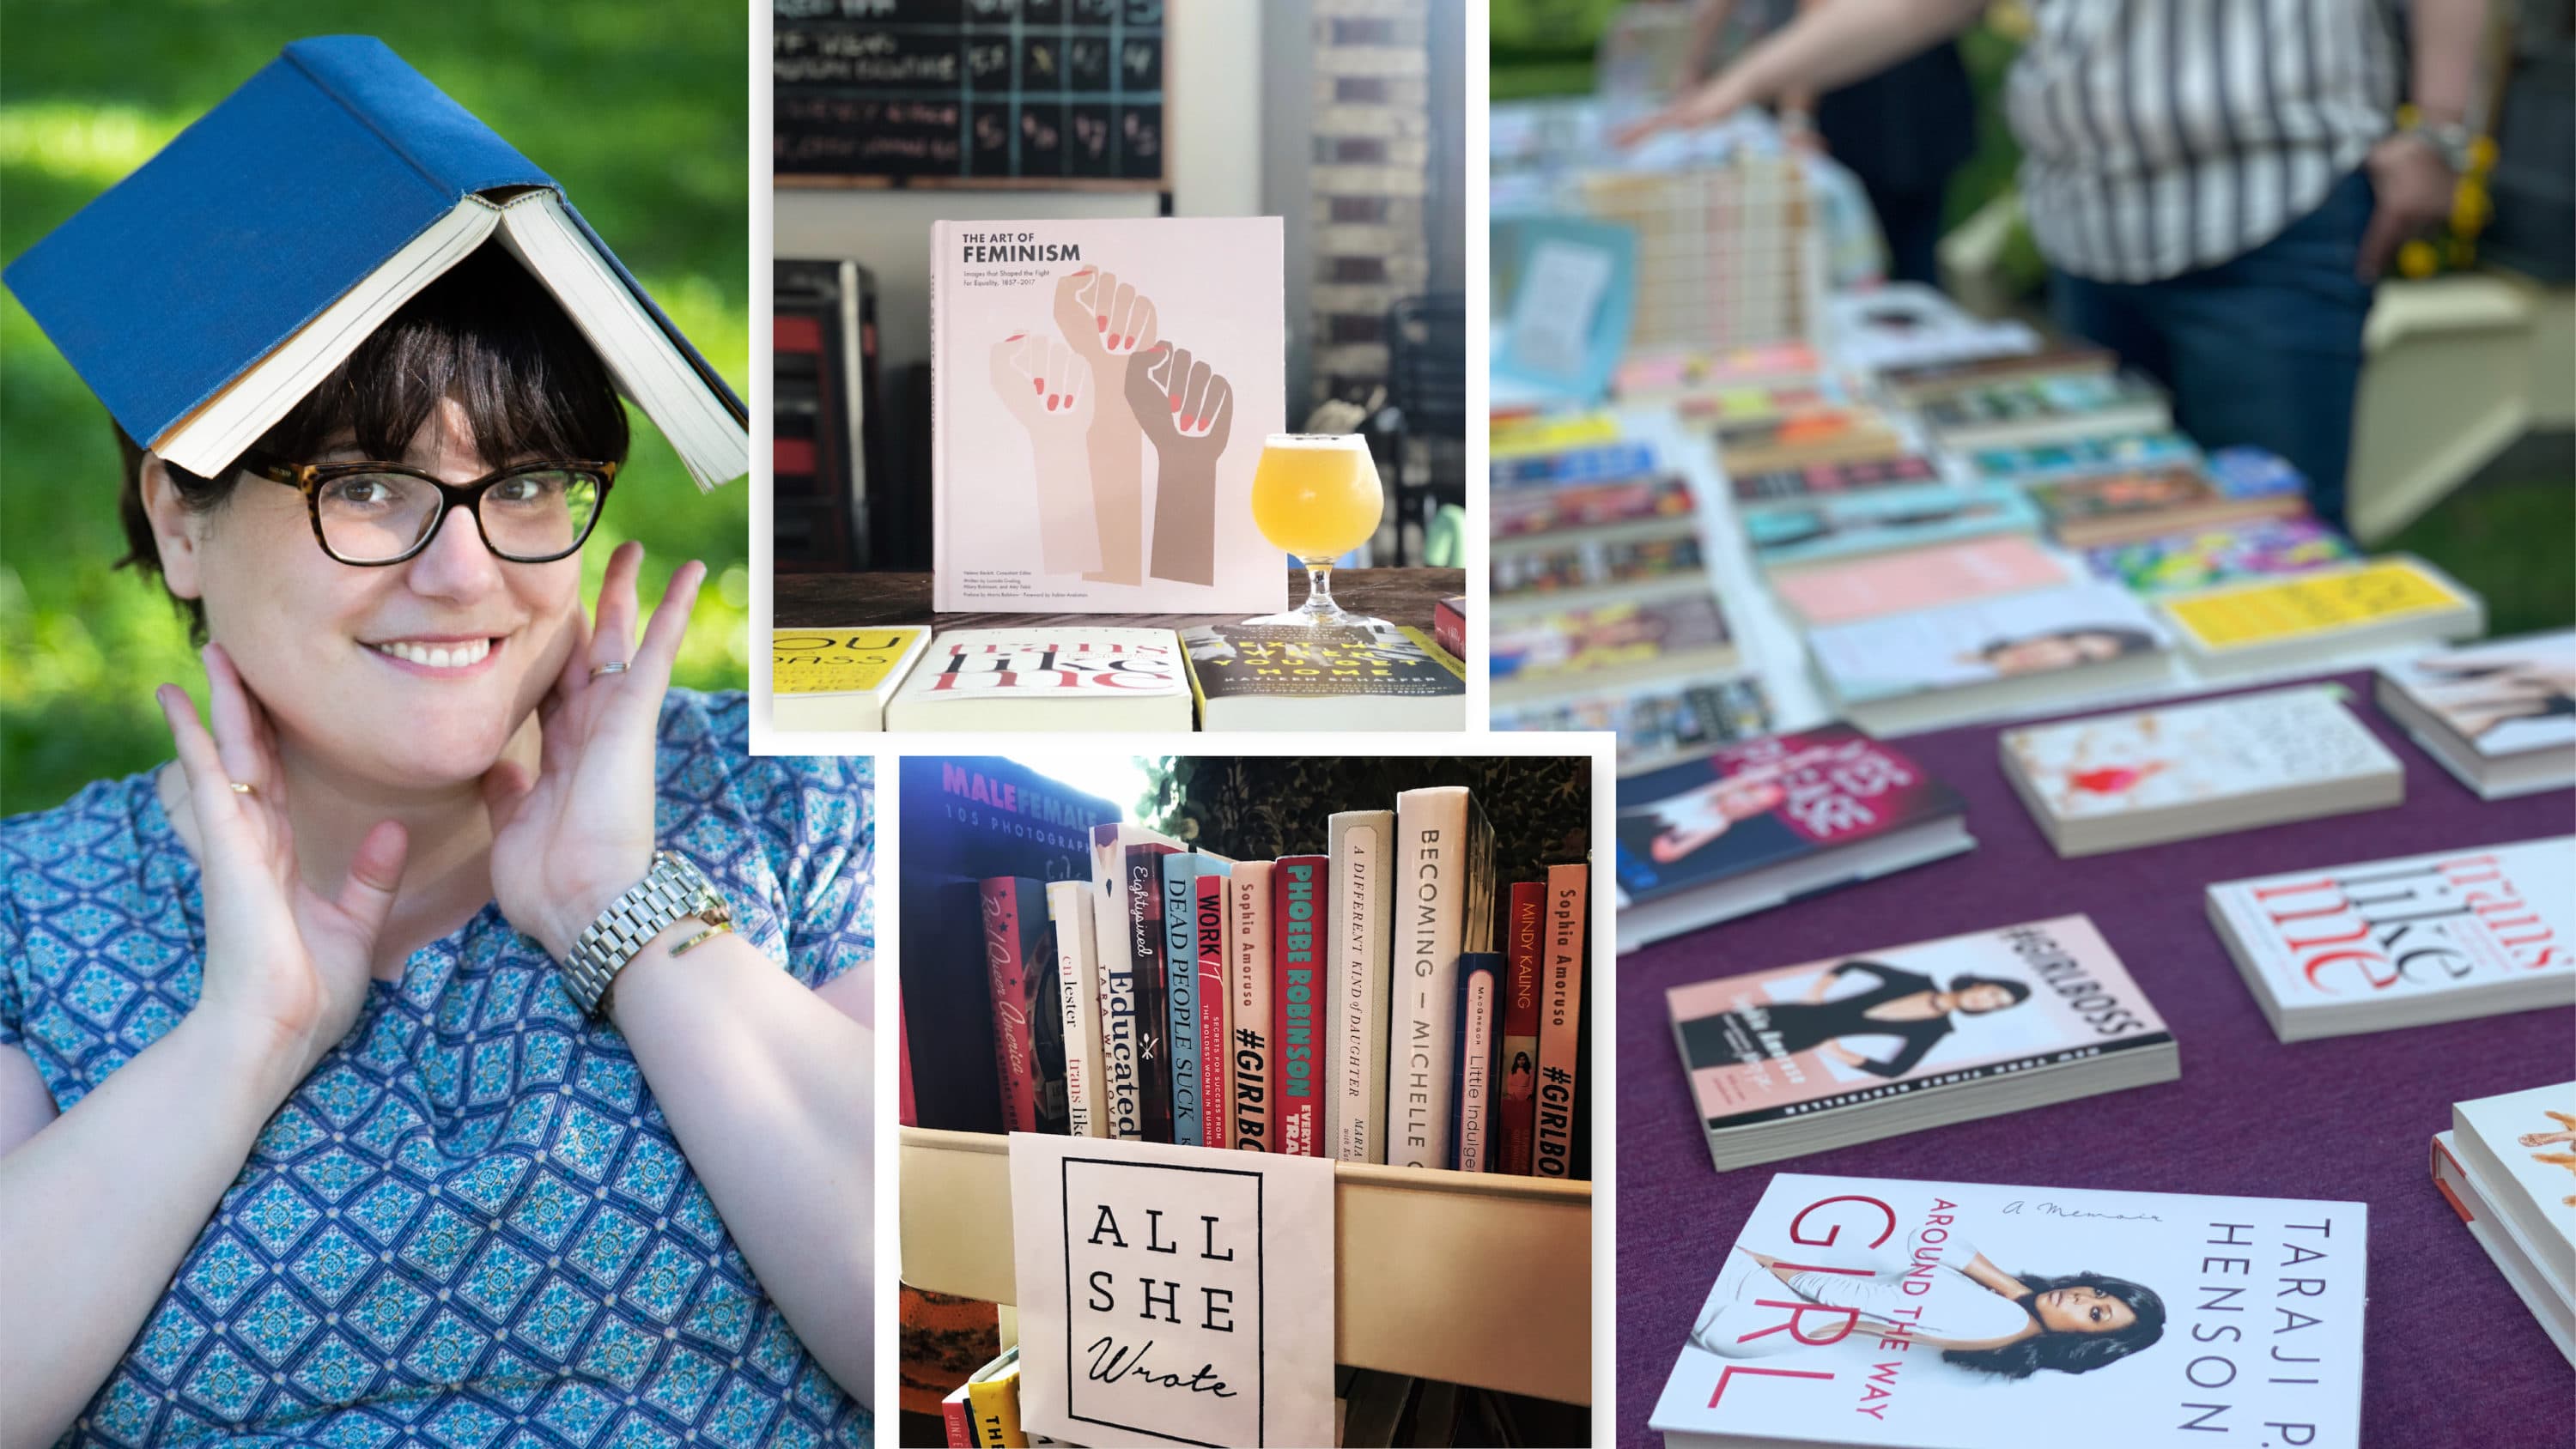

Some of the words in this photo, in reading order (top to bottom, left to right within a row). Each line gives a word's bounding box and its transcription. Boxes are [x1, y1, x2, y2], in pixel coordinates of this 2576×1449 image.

[963, 233, 985, 243] THE
[989, 233, 1013, 243] ART
[1018, 233, 1035, 242] OF
[963, 244, 1081, 263] FEMINISM
[945, 652, 1170, 671] like
[1242, 649, 1374, 658] WHEN
[945, 803, 979, 827] 105
[1353, 846, 1365, 855] A
[1128, 865, 1154, 958] Eightysixed
[1169, 879, 1189, 950] DEAD
[1199, 894, 1220, 956] WORK
[1240, 883, 1255, 935] Sophia
[1287, 865, 1313, 962] PHOEBE
[1352, 862, 1365, 955] DIFFERENT
[1415, 829, 1440, 979] BECOMING
[1519, 902, 1538, 950] MINDY
[1546, 889, 1576, 946] Sophia
[2336, 864, 2474, 985] like
[2437, 855, 2575, 976] trans
[2251, 876, 2399, 996] me
[1064, 981, 1078, 1028] lester
[1099, 965, 1109, 1018] TARA
[1171, 957, 1192, 1051] PEOPLE
[1242, 943, 1255, 1007] Amoruso
[1351, 961, 1364, 1000] KIND
[1517, 955, 1532, 1009] KALING
[1544, 955, 1571, 1027] Amoruso
[1285, 969, 1312, 1098] ROBINSON
[1352, 1000, 1364, 1014] of
[999, 1000, 1026, 1076] America
[1109, 969, 1141, 1137] Educated
[1348, 1014, 1363, 1097] DAUGHTER
[1069, 1058, 1081, 1104] trans
[1176, 1057, 1194, 1121] SUCK
[1206, 1099, 1211, 1108] IN
[1407, 1019, 1431, 1149] MICHELLE
[1468, 1055, 1484, 1100] Little
[1353, 1118, 1364, 1158] MARIA
[1462, 1105, 1482, 1172] Indulge
[1087, 1204, 1234, 1262] ALL
[2002, 1201, 2025, 1215] A
[2037, 1203, 2163, 1222] Memoir
[1902, 1197, 1959, 1297] AROUND
[1089, 1270, 1234, 1333] SHE
[1707, 1195, 1897, 1409] GIRL
[1879, 1306, 1923, 1352] THE
[2178, 1222, 2254, 1433] HENSON
[2269, 1218, 2330, 1384] TARAJI
[1087, 1337, 1237, 1397] Wrote
[1856, 1361, 1903, 1421] WAY
[949, 1415, 962, 1440] JUNE
[2261, 1422, 2316, 1449] P.
